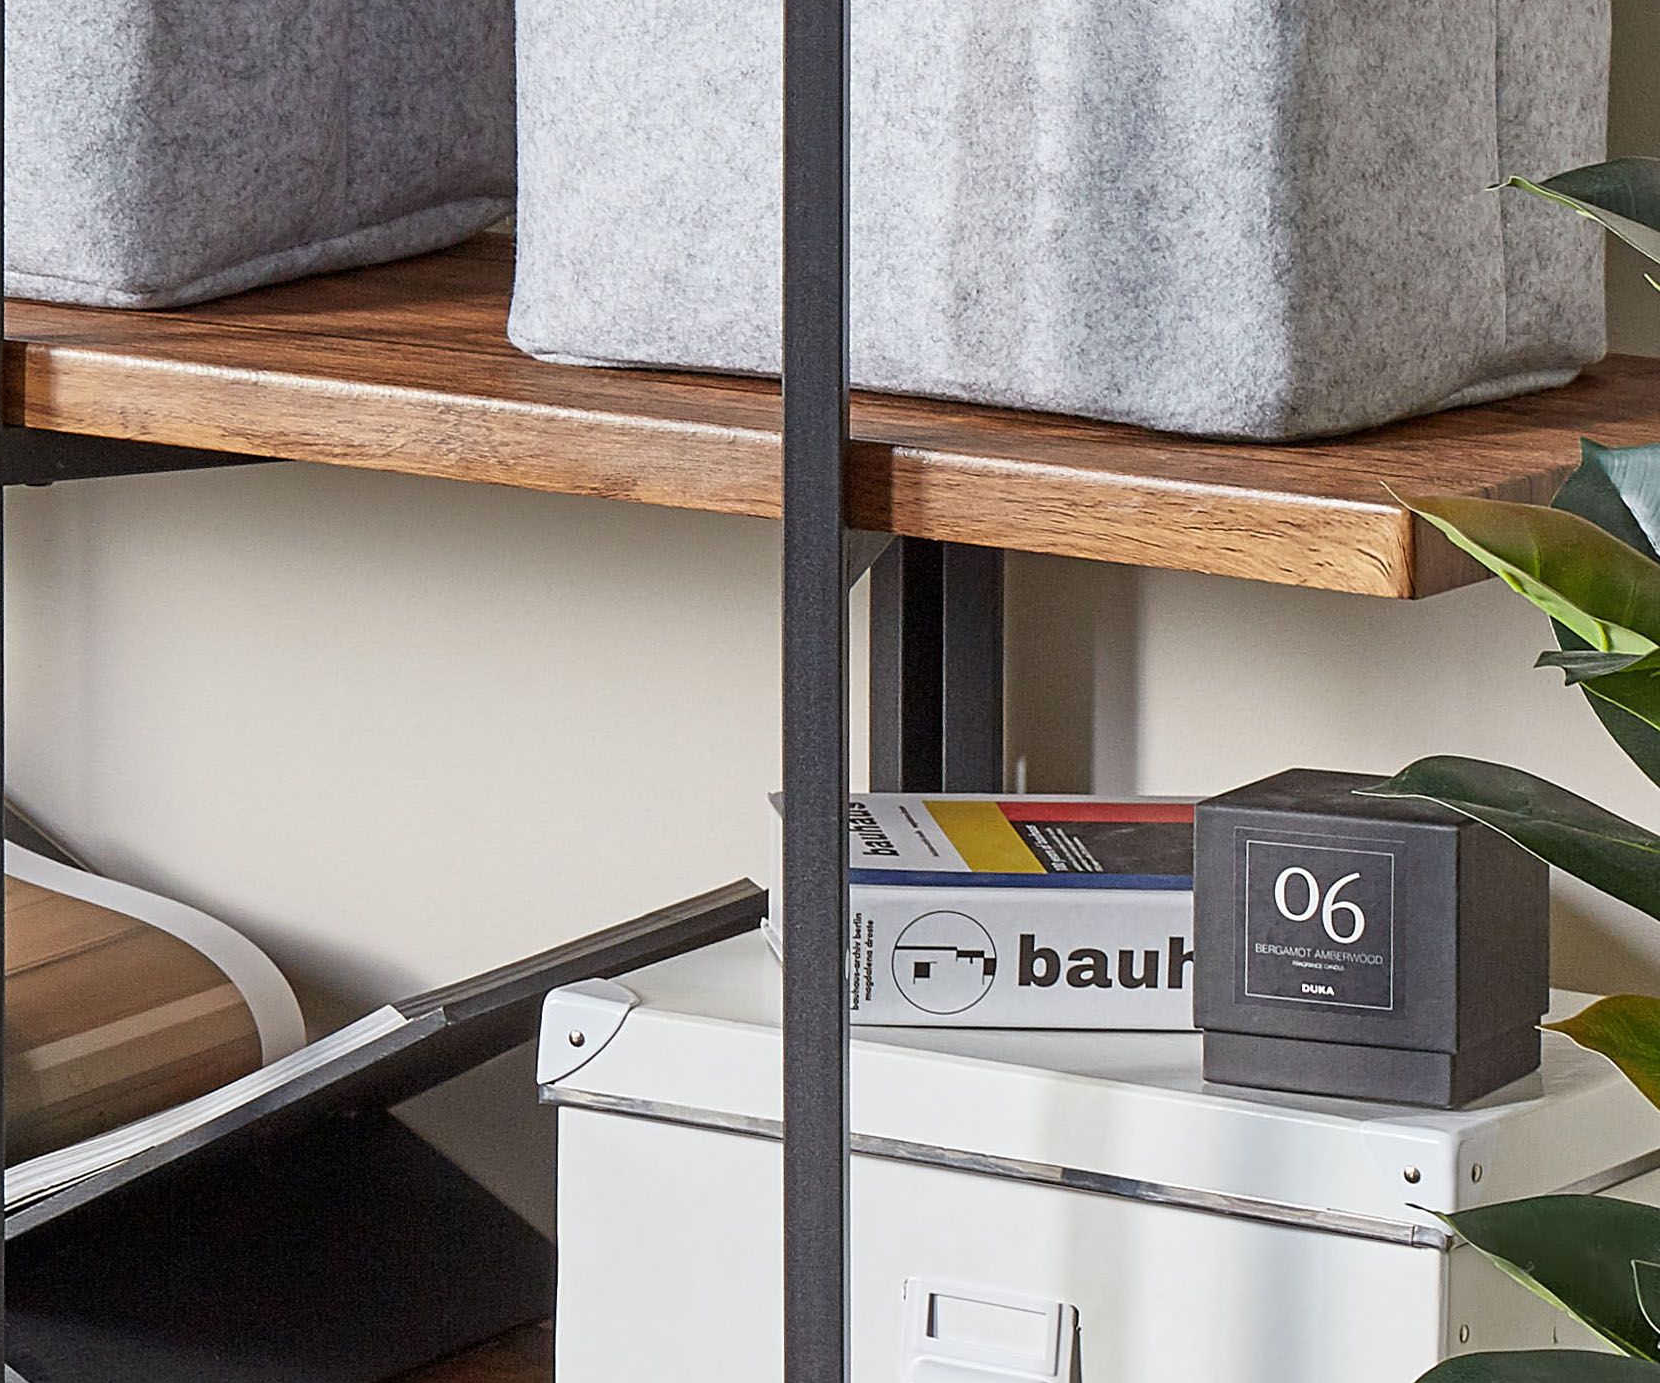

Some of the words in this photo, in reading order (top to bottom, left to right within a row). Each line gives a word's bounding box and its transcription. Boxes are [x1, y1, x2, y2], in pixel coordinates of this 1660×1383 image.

[1274, 866, 1366, 944] 06
[852, 912, 862, 939] berlin
[1255, 943, 1312, 959] BERGAMOT
[1314, 948, 1384, 966] AMBERWOOD
[1301, 983, 1335, 997] DUKA
